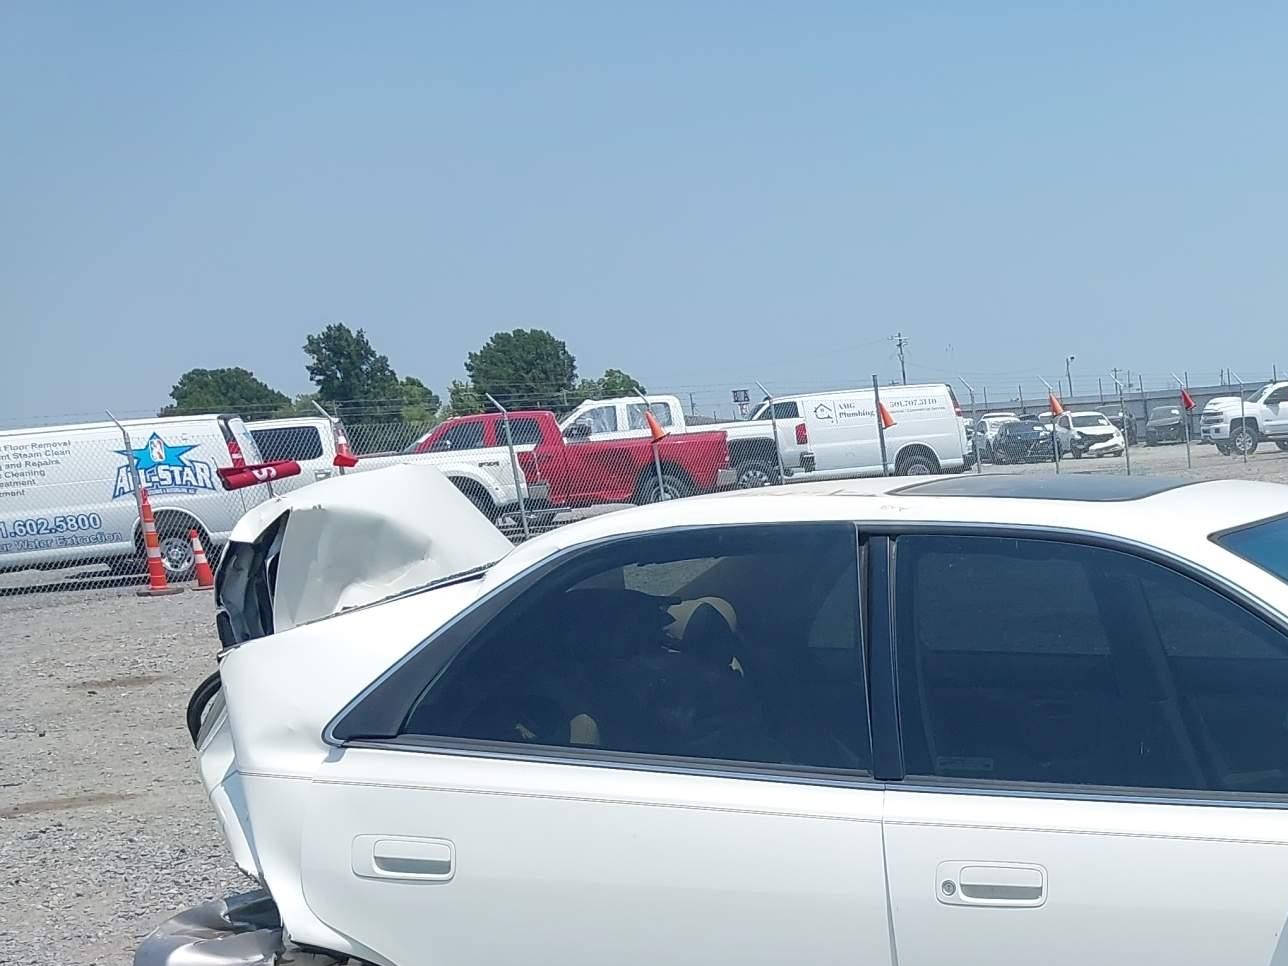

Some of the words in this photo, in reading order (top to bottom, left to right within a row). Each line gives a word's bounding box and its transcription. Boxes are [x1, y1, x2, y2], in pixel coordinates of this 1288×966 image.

[838, 409, 876, 419] Plumbing
[31, 440, 72, 450] Removal
[12, 452, 42, 460] Steam
[5, 462, 22, 470] and
[24, 459, 61, 468] Repairs
[4, 469, 46, 479] Cleaning
[15, 538, 53, 551] Water
[56, 532, 122, 547] Extraction
